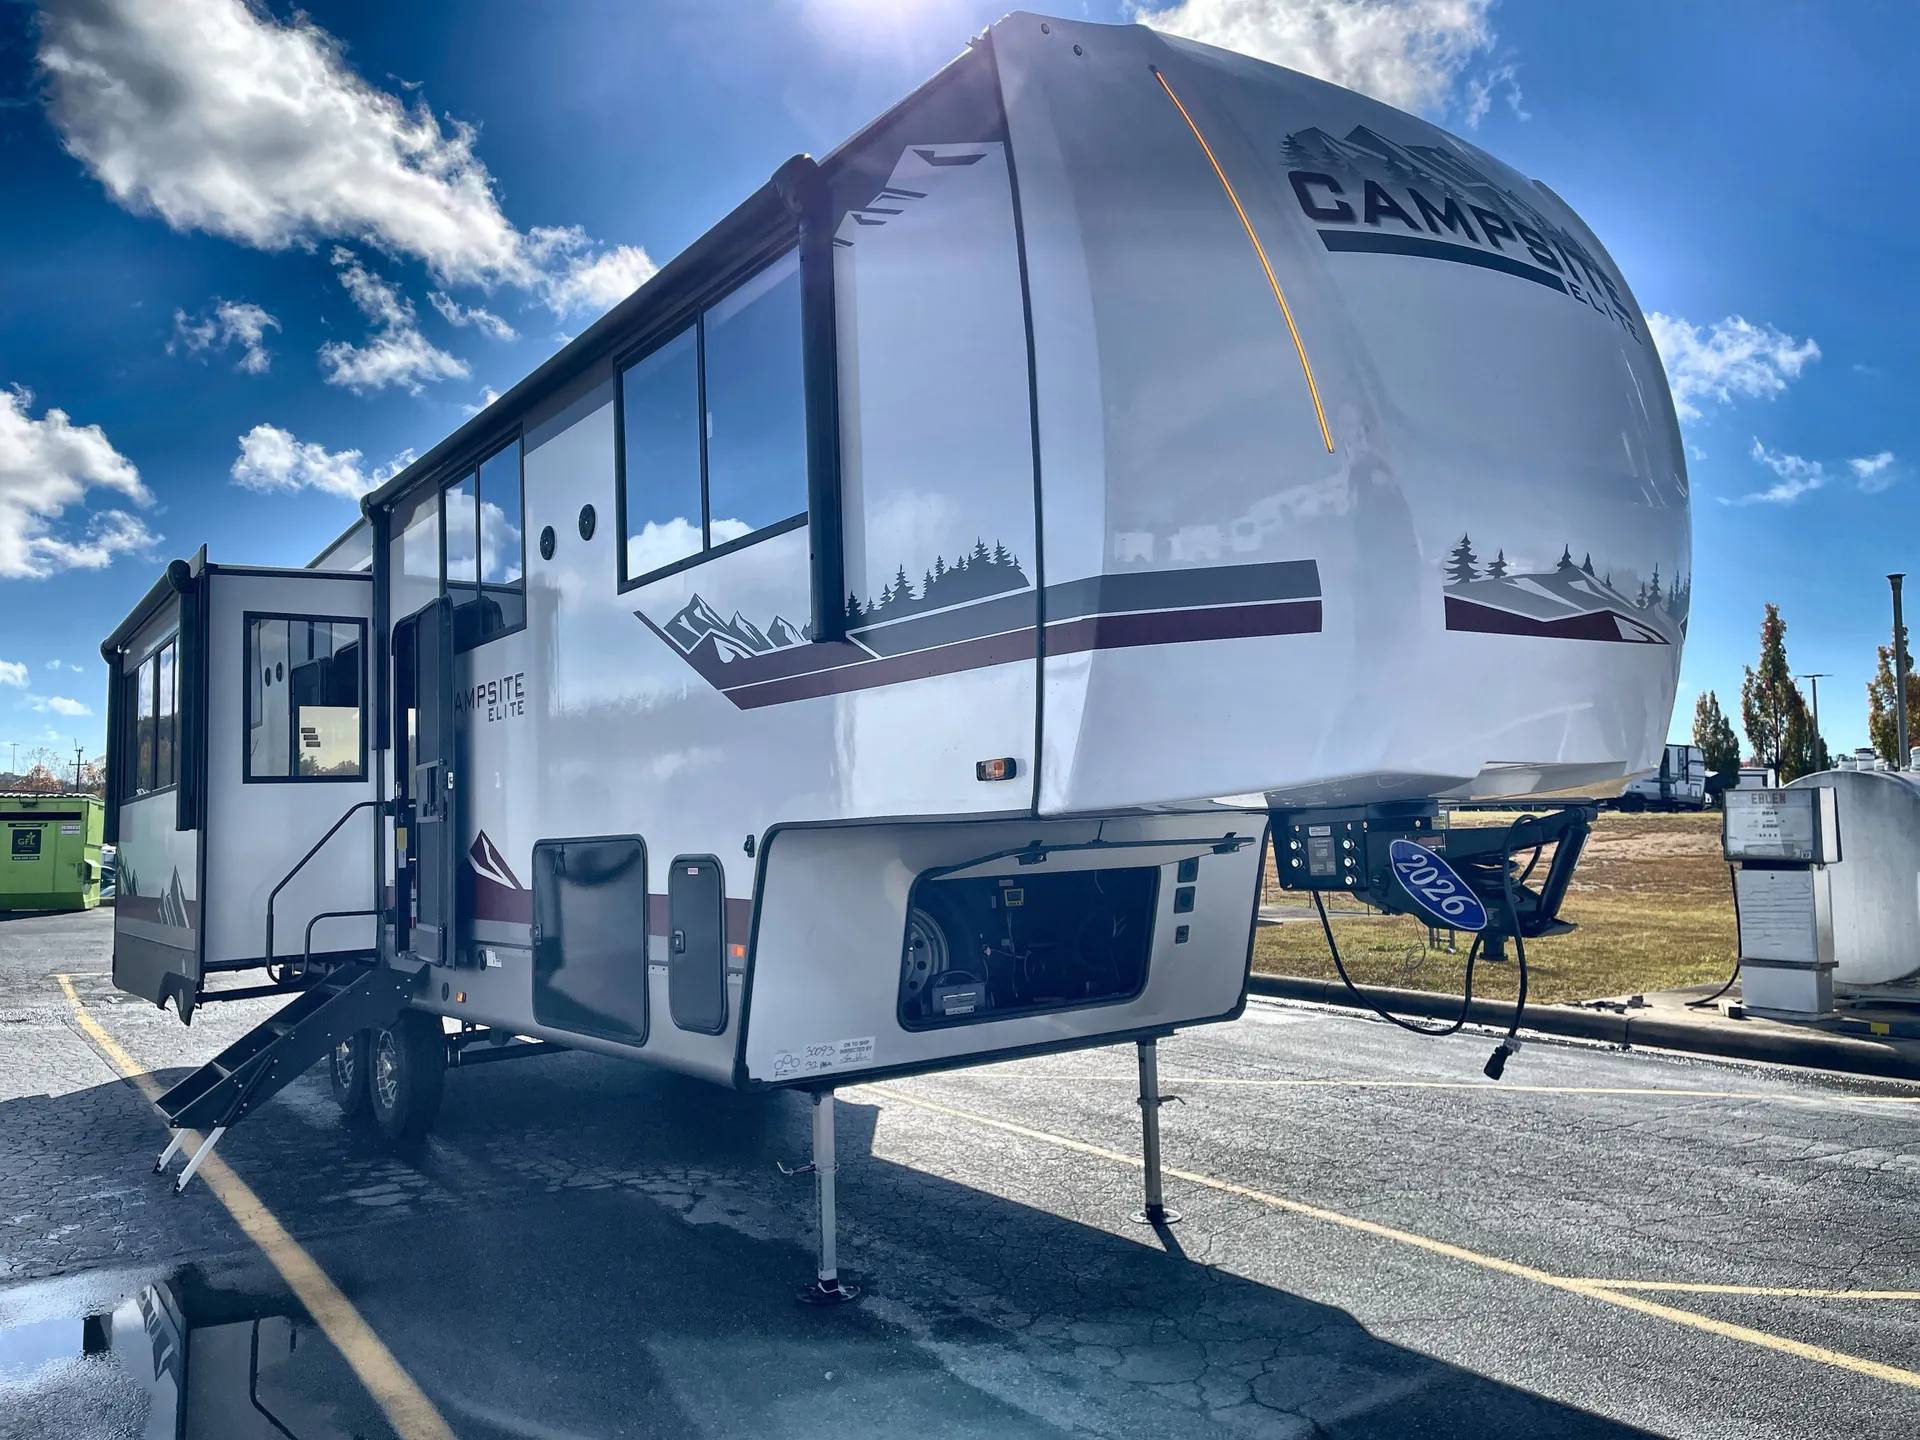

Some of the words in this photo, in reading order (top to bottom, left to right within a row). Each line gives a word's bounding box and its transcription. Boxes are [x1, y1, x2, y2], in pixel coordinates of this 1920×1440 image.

[1288, 170, 1633, 323] CAMPSITE
[1566, 280, 1643, 345] ELITE
[455, 672, 524, 713] AMPSITE
[488, 700, 525, 722] ELITE
[17, 834, 36, 845] GFL
[1396, 854, 1477, 915] 2026
